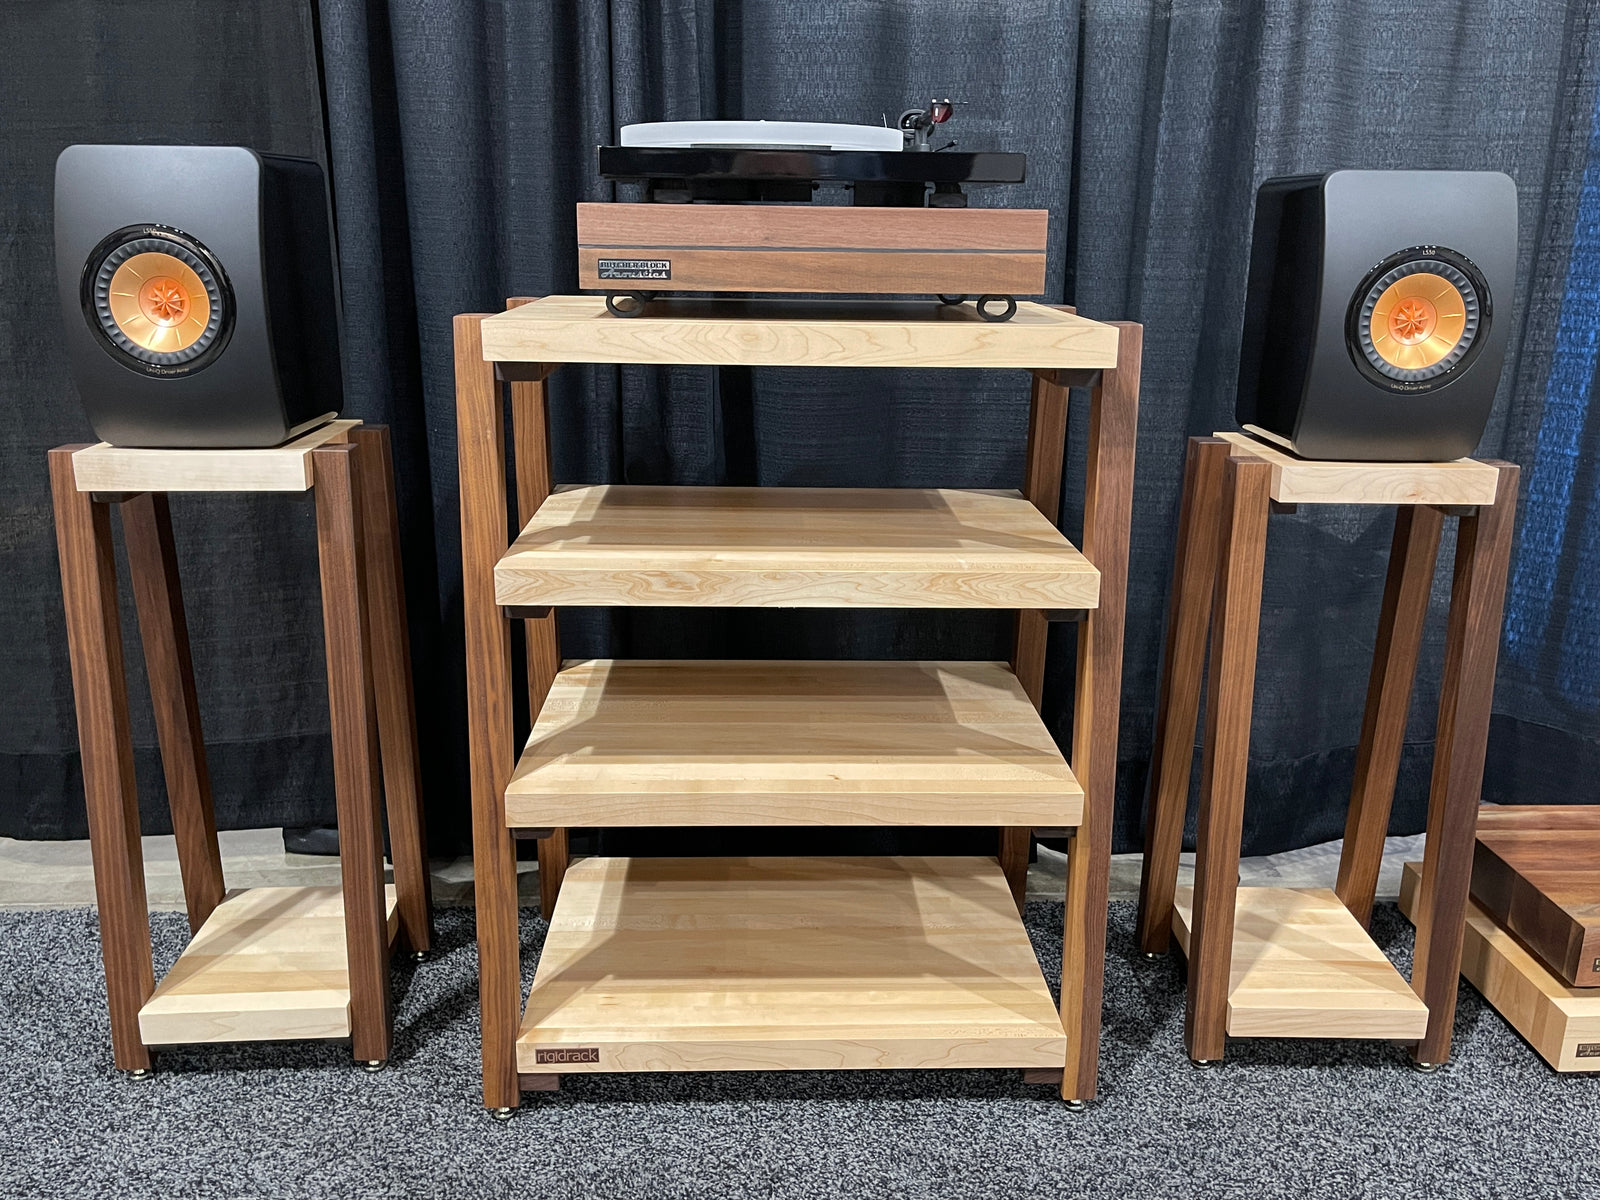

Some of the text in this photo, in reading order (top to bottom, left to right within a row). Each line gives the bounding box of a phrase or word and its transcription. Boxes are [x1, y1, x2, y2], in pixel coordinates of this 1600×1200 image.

[600, 261, 639, 269] BUTCHER
[600, 269, 668, 279] Acoustics
[537, 1048, 598, 1063] rigidrack
